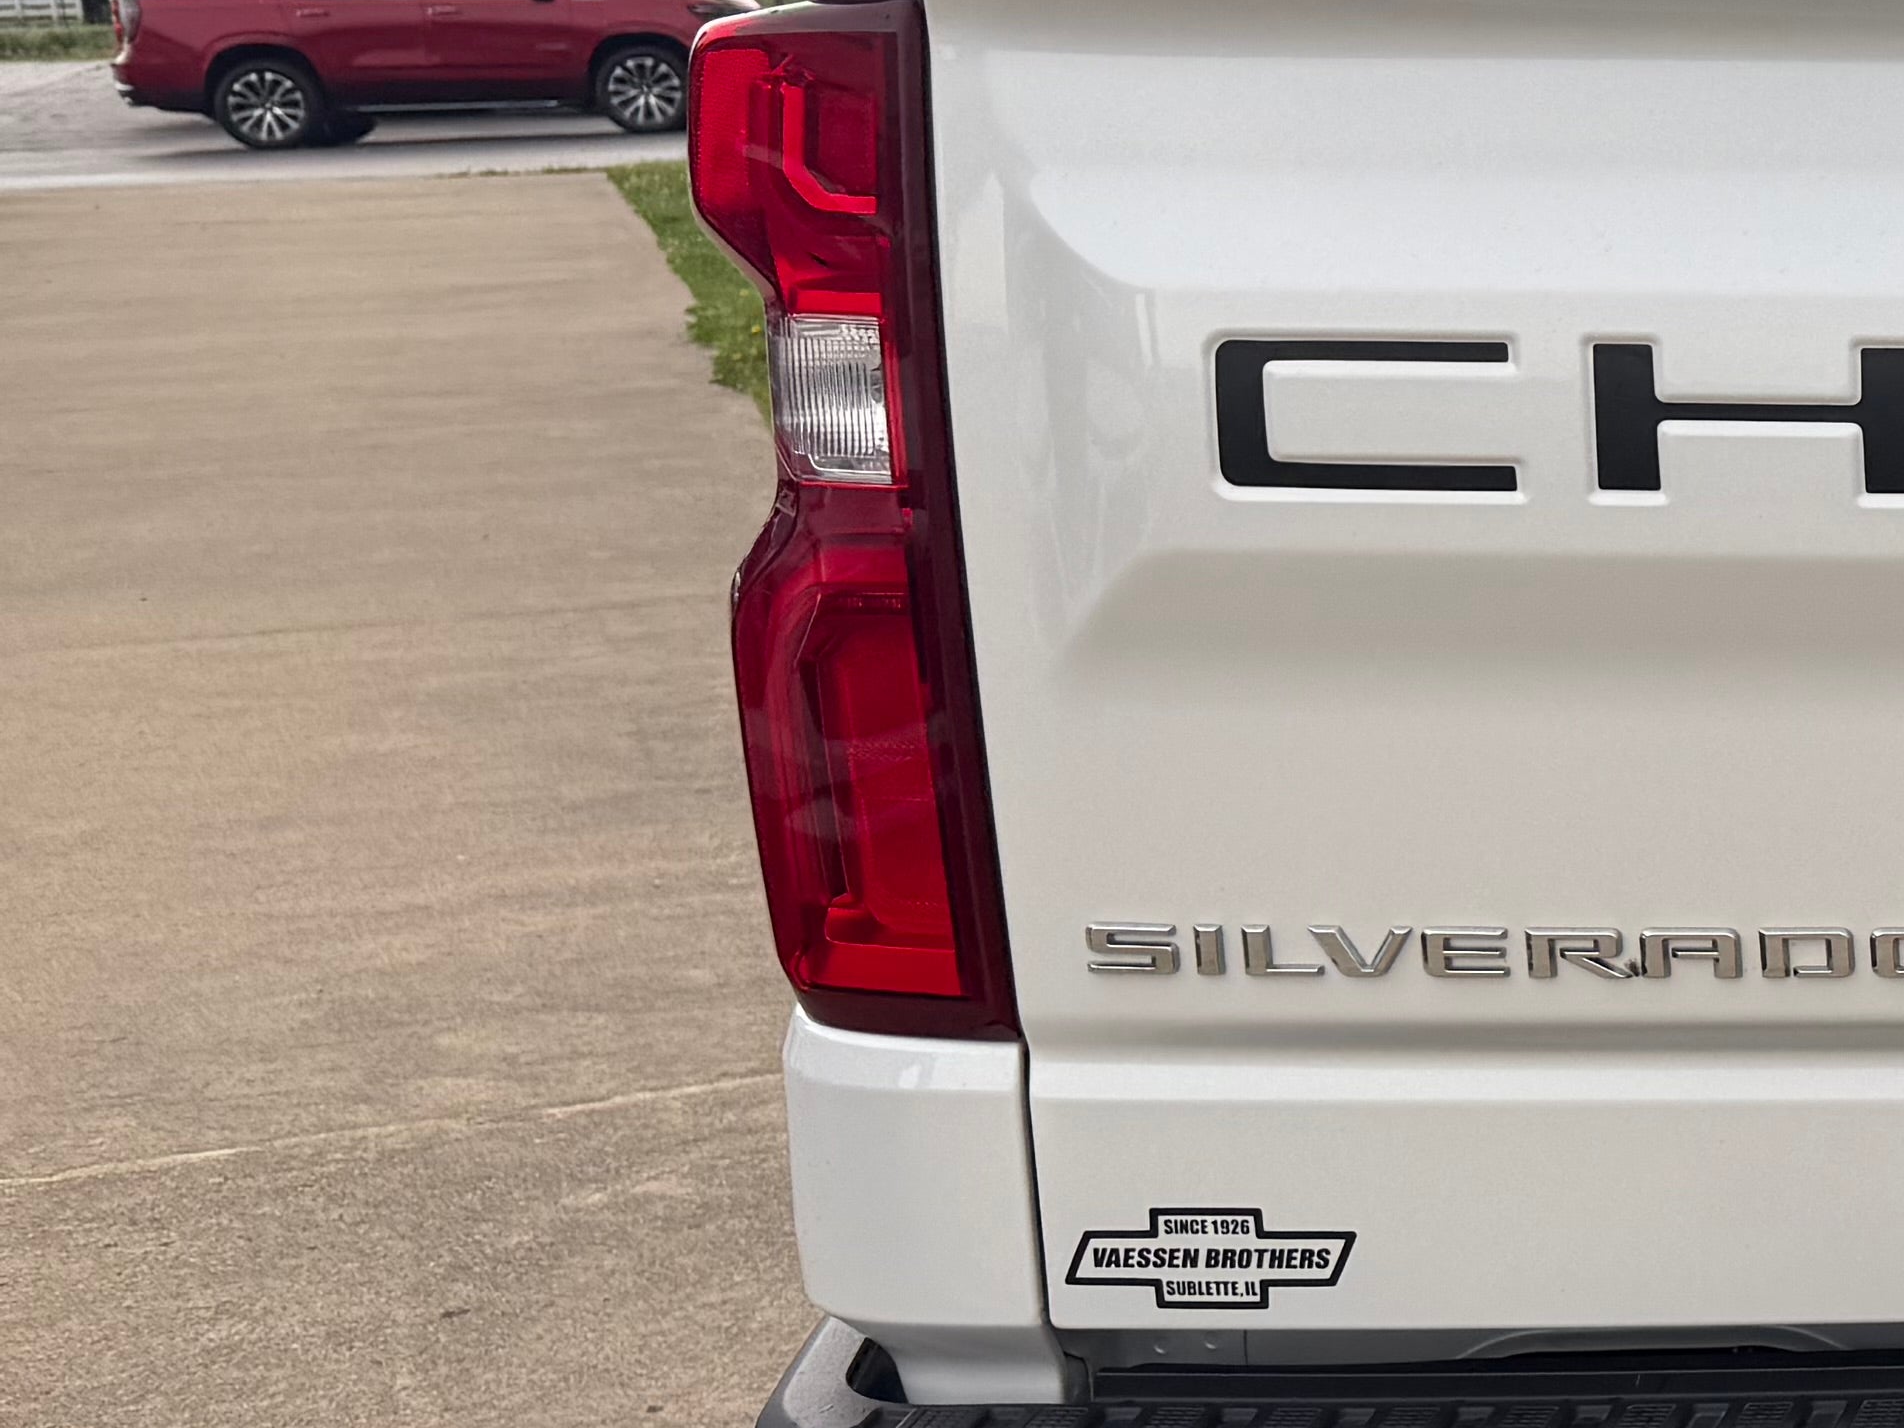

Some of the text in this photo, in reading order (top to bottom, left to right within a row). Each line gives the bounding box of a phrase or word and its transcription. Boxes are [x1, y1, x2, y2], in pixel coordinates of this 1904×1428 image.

[1163, 1219, 1250, 1235] SINCE 1926
[1092, 1247, 1332, 1270] VAESSEN BROTHERS
